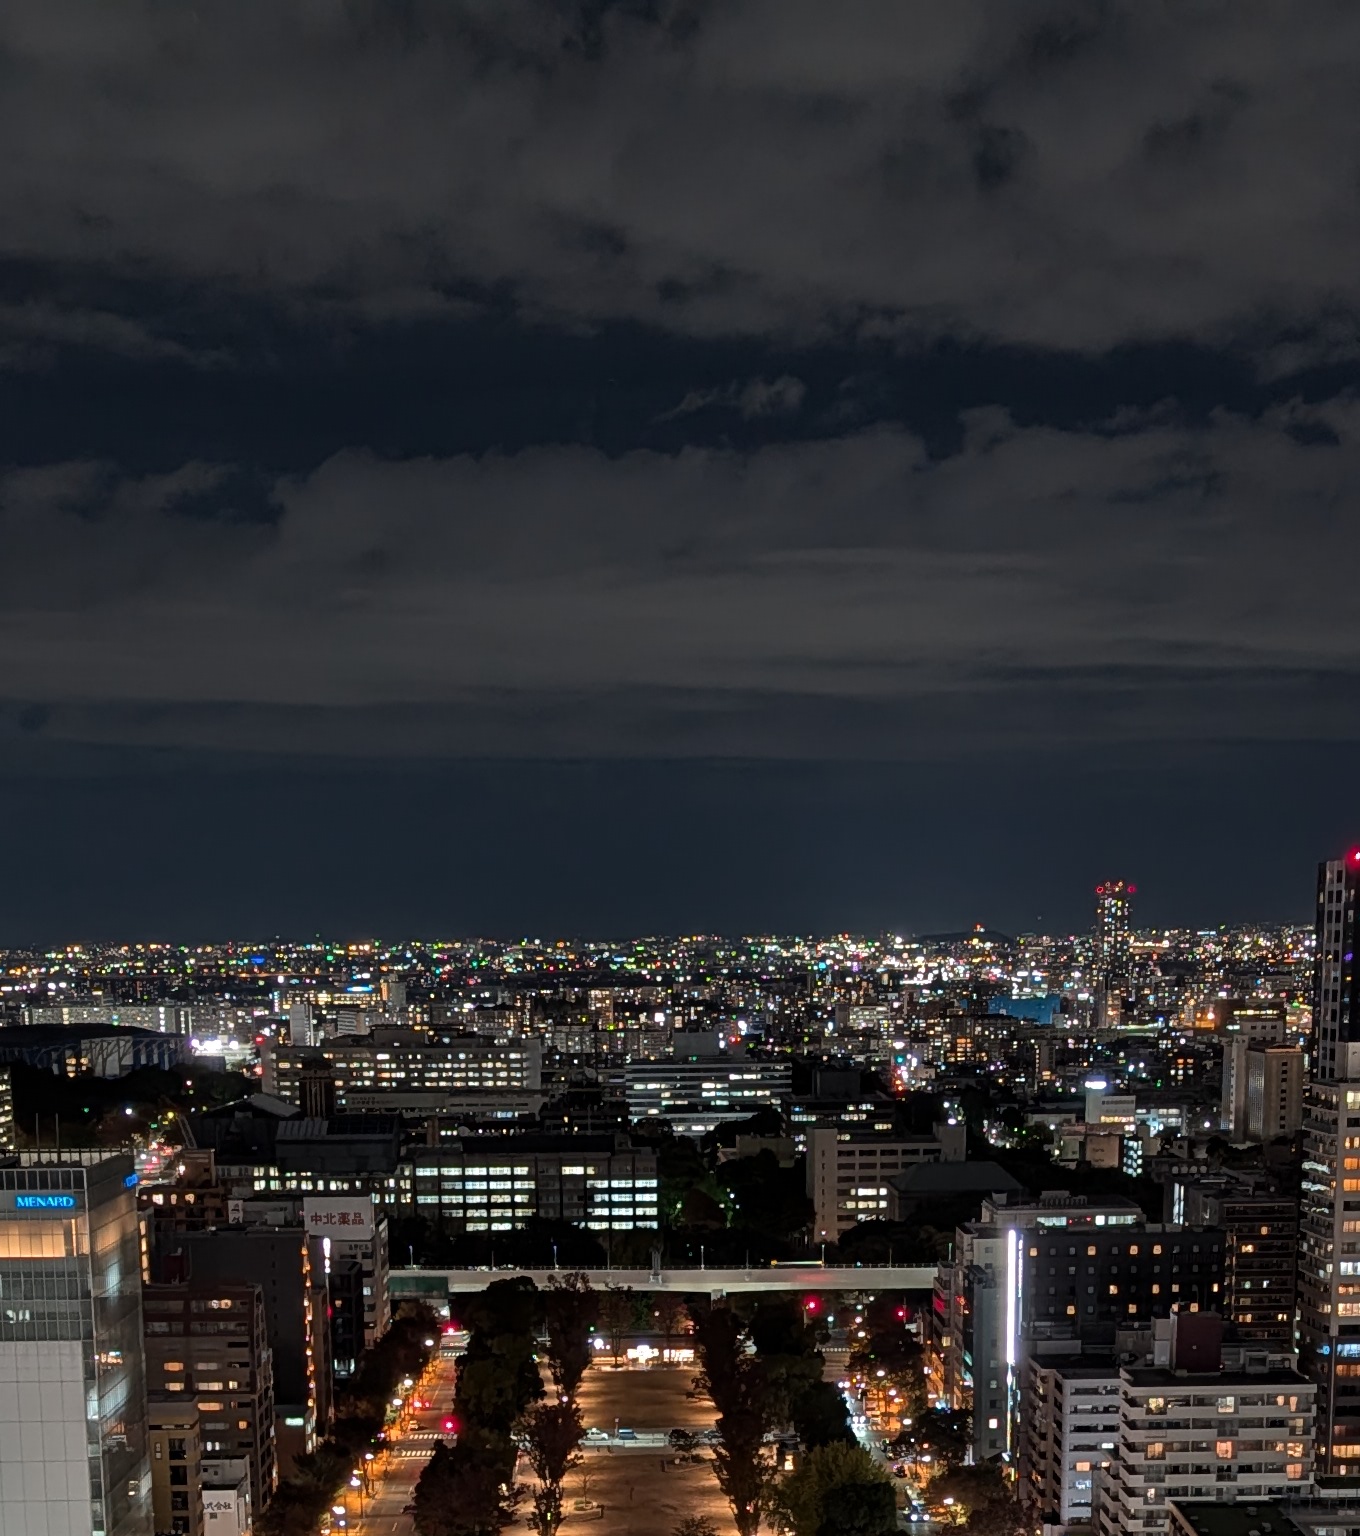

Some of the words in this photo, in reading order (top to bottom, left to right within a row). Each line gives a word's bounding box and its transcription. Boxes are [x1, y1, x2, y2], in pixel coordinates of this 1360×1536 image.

[16, 1196, 75, 1207] MENARD
[310, 1211, 365, 1226] 中北薬品
